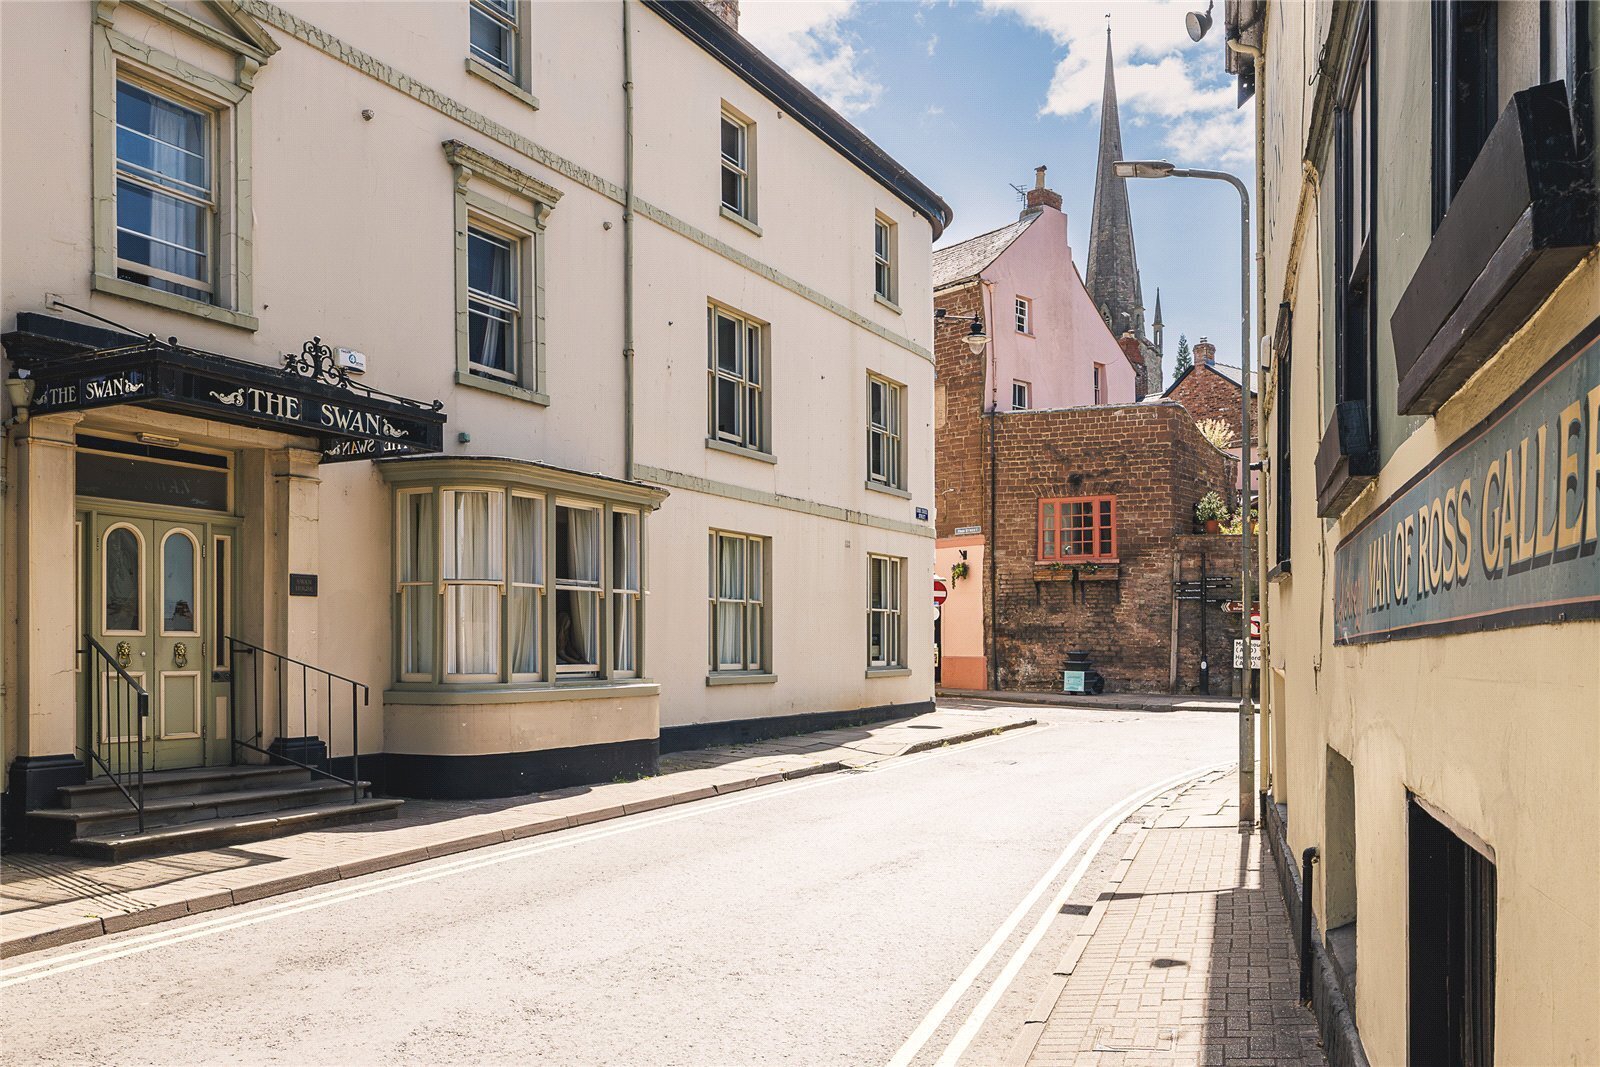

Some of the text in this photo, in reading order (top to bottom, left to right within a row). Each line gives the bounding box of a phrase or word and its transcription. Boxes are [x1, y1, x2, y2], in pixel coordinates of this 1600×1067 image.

[50, 377, 125, 405] THE SWAN
[248, 387, 381, 436] THE SWAN
[1367, 530, 1391, 613] MAN
[1394, 514, 1414, 605] OF
[1417, 477, 1471, 599] ROSS
